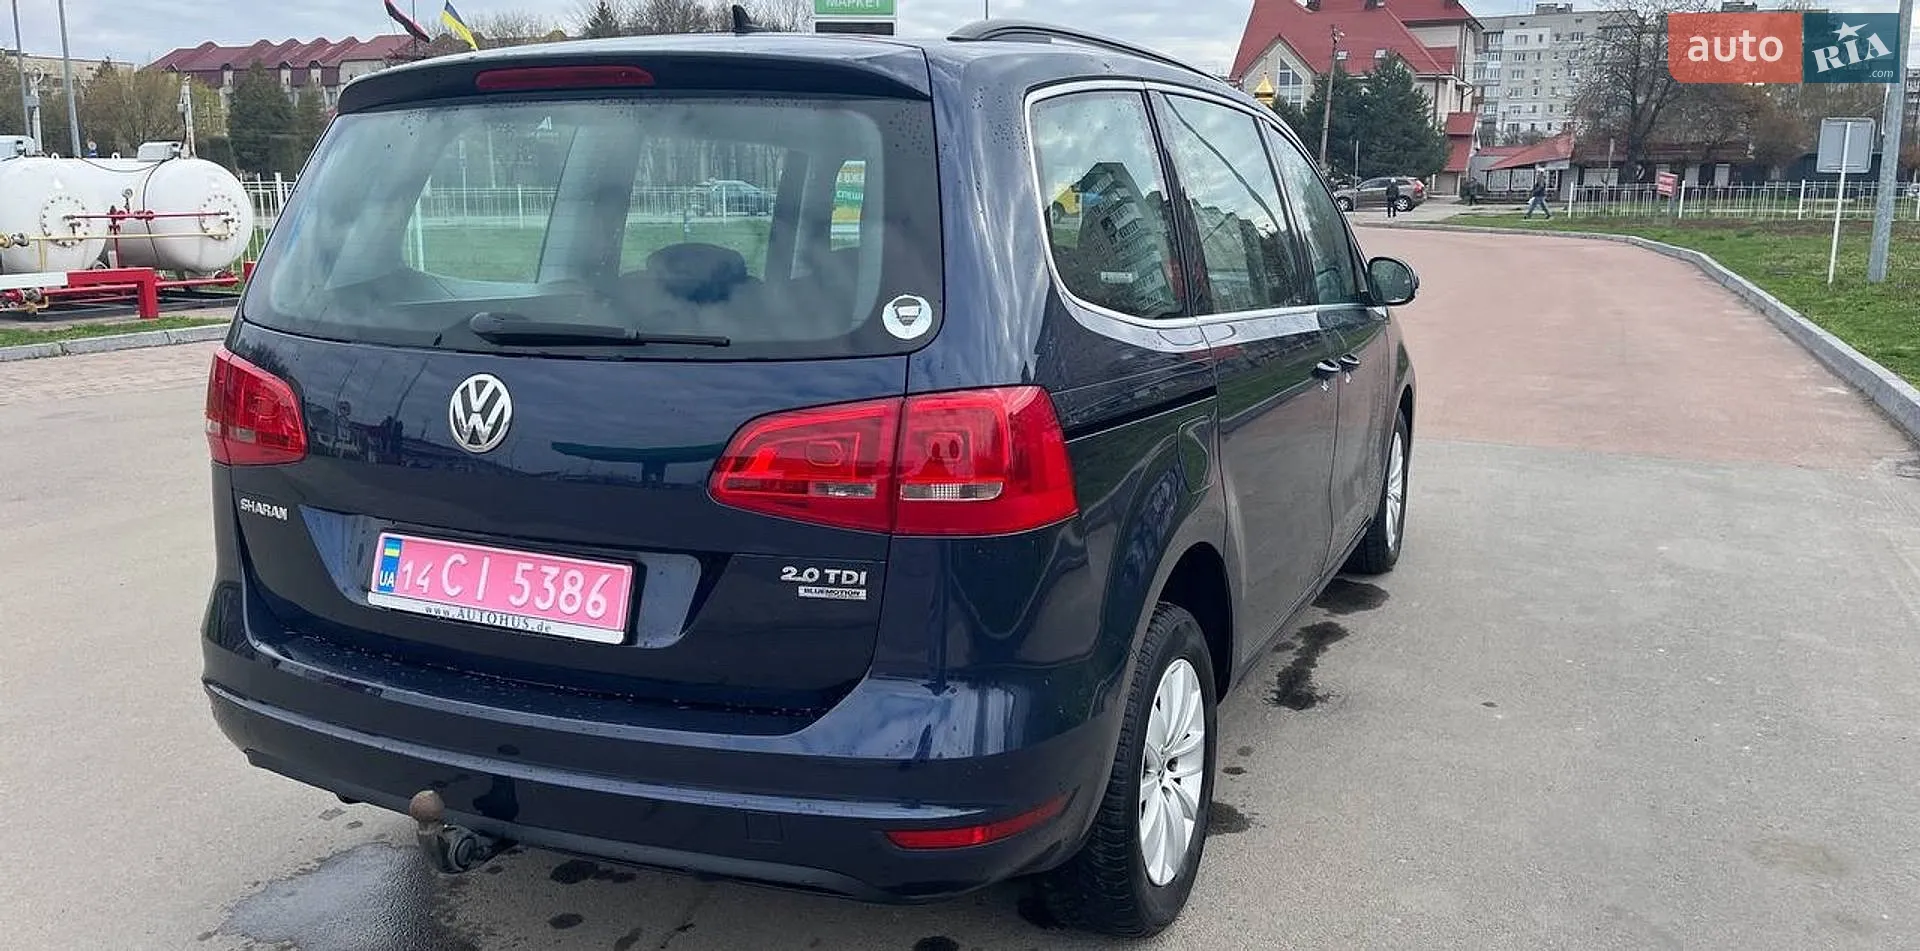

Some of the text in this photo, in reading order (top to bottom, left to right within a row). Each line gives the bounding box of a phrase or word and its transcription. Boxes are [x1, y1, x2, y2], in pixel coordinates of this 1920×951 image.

[239, 497, 288, 521] SHARAN
[379, 570, 396, 588] UA
[824, 568, 867, 585] TDI
[402, 560, 434, 593] 14
[508, 562, 612, 619] 5386
[424, 604, 552, 633] www.AUTOHUS.de
